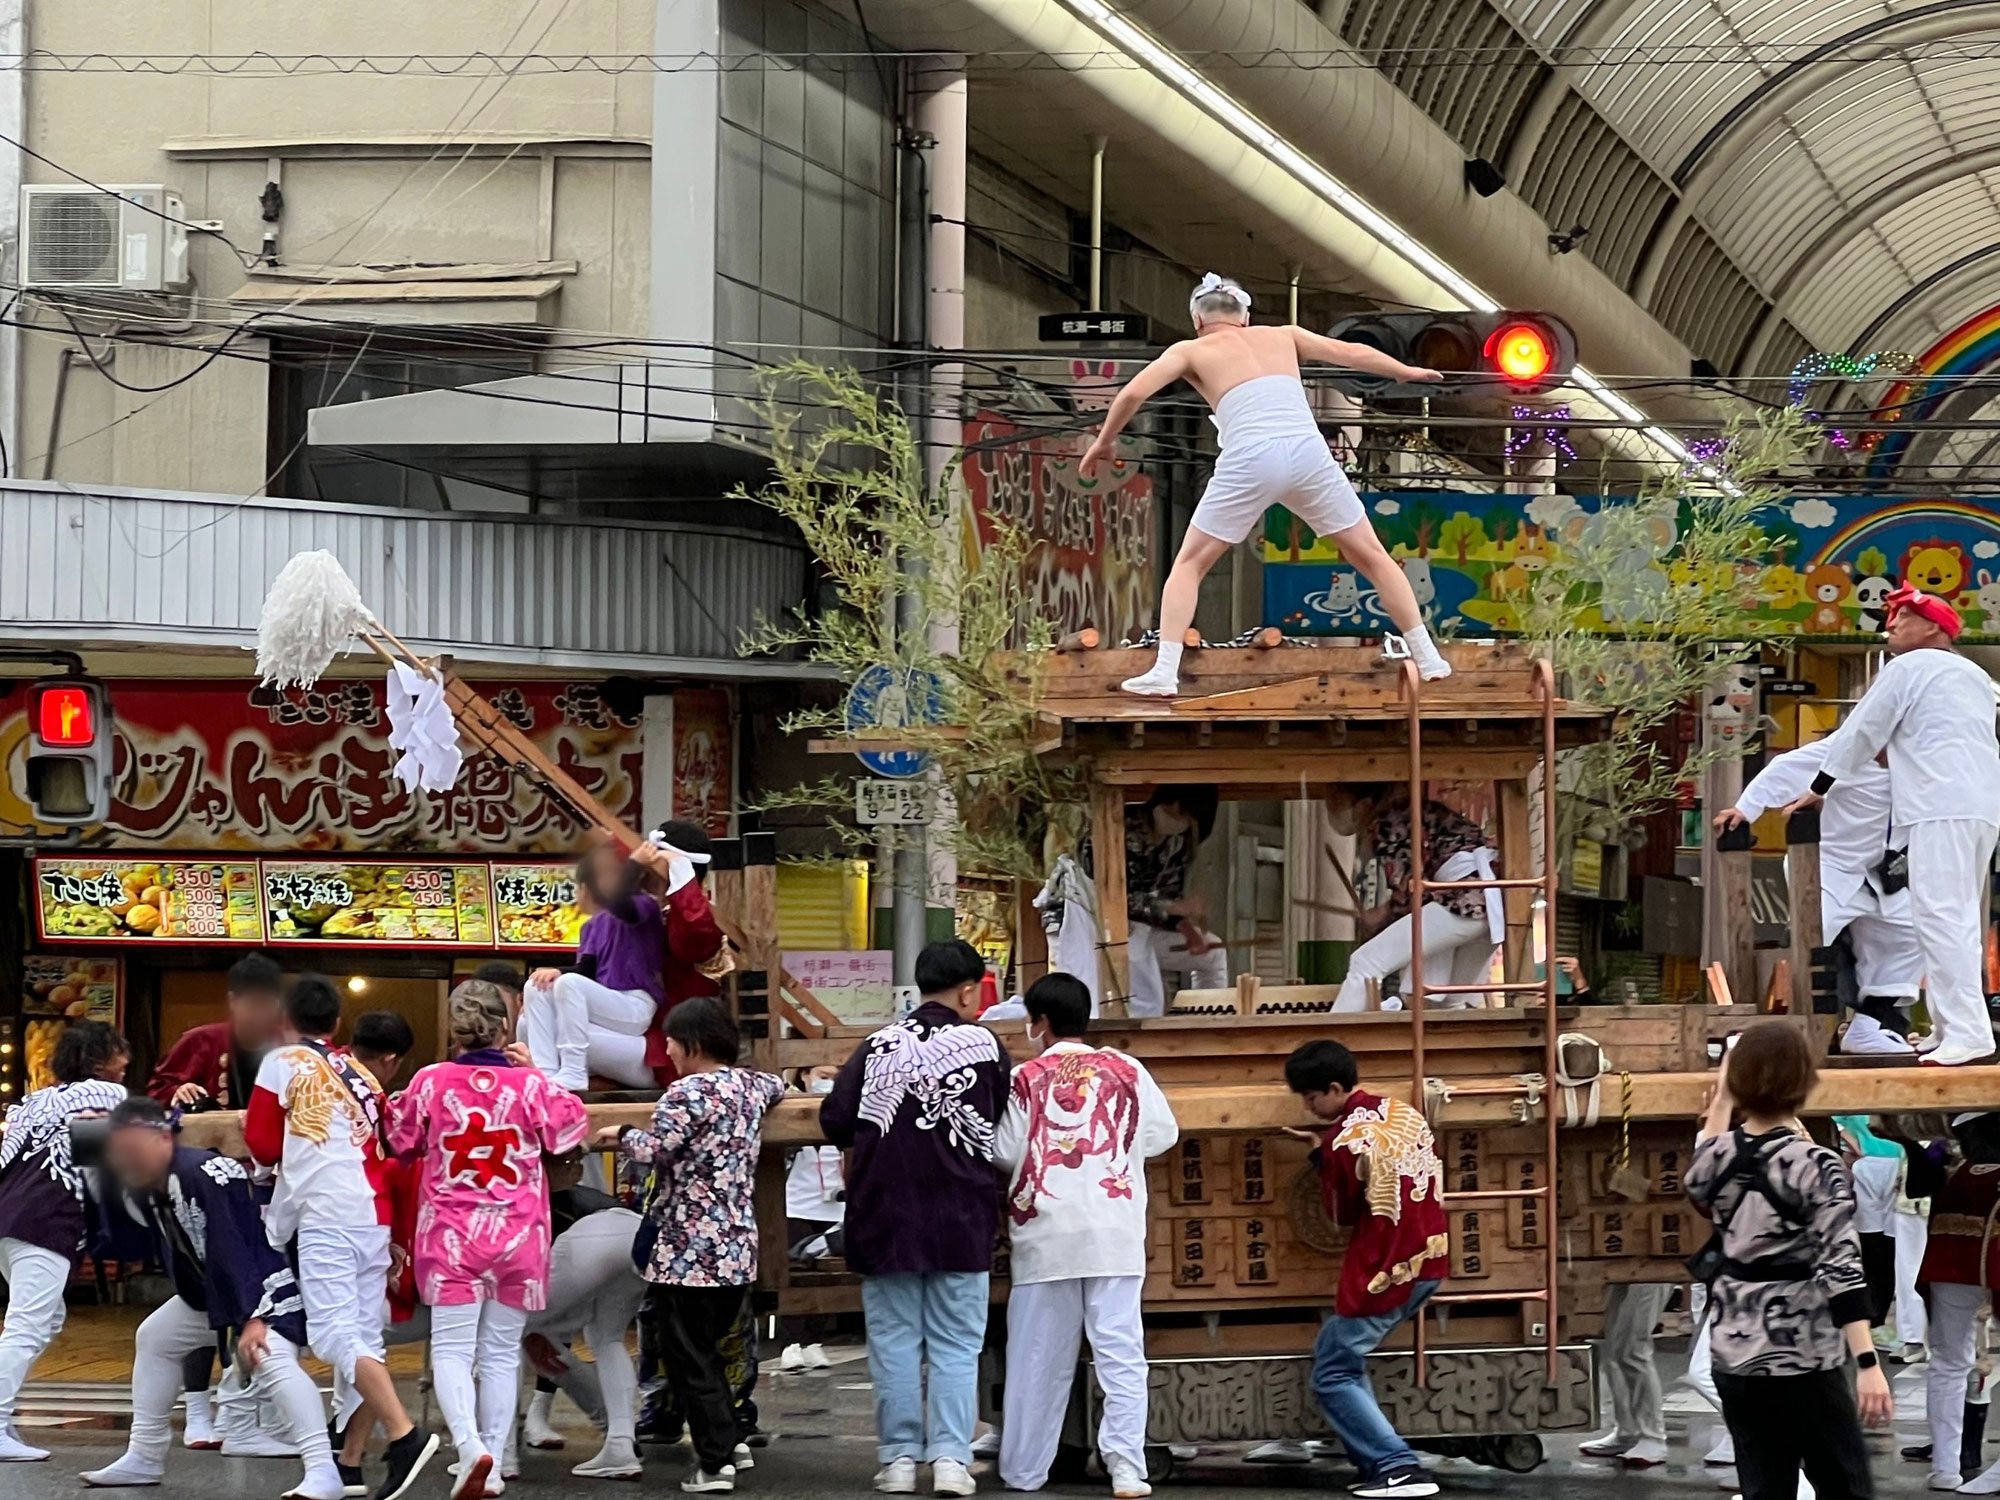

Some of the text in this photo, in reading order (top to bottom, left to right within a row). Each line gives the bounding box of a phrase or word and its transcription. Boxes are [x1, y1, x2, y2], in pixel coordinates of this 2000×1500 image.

[176, 870, 212, 887] 350
[403, 871, 442, 890] 450
[41, 870, 128, 908] たこ焼
[184, 889, 214, 903] 500
[413, 891, 444, 906] 450
[186, 904, 216, 919] 650
[187, 919, 217, 935] 800
[441, 1109, 522, 1191] 女
